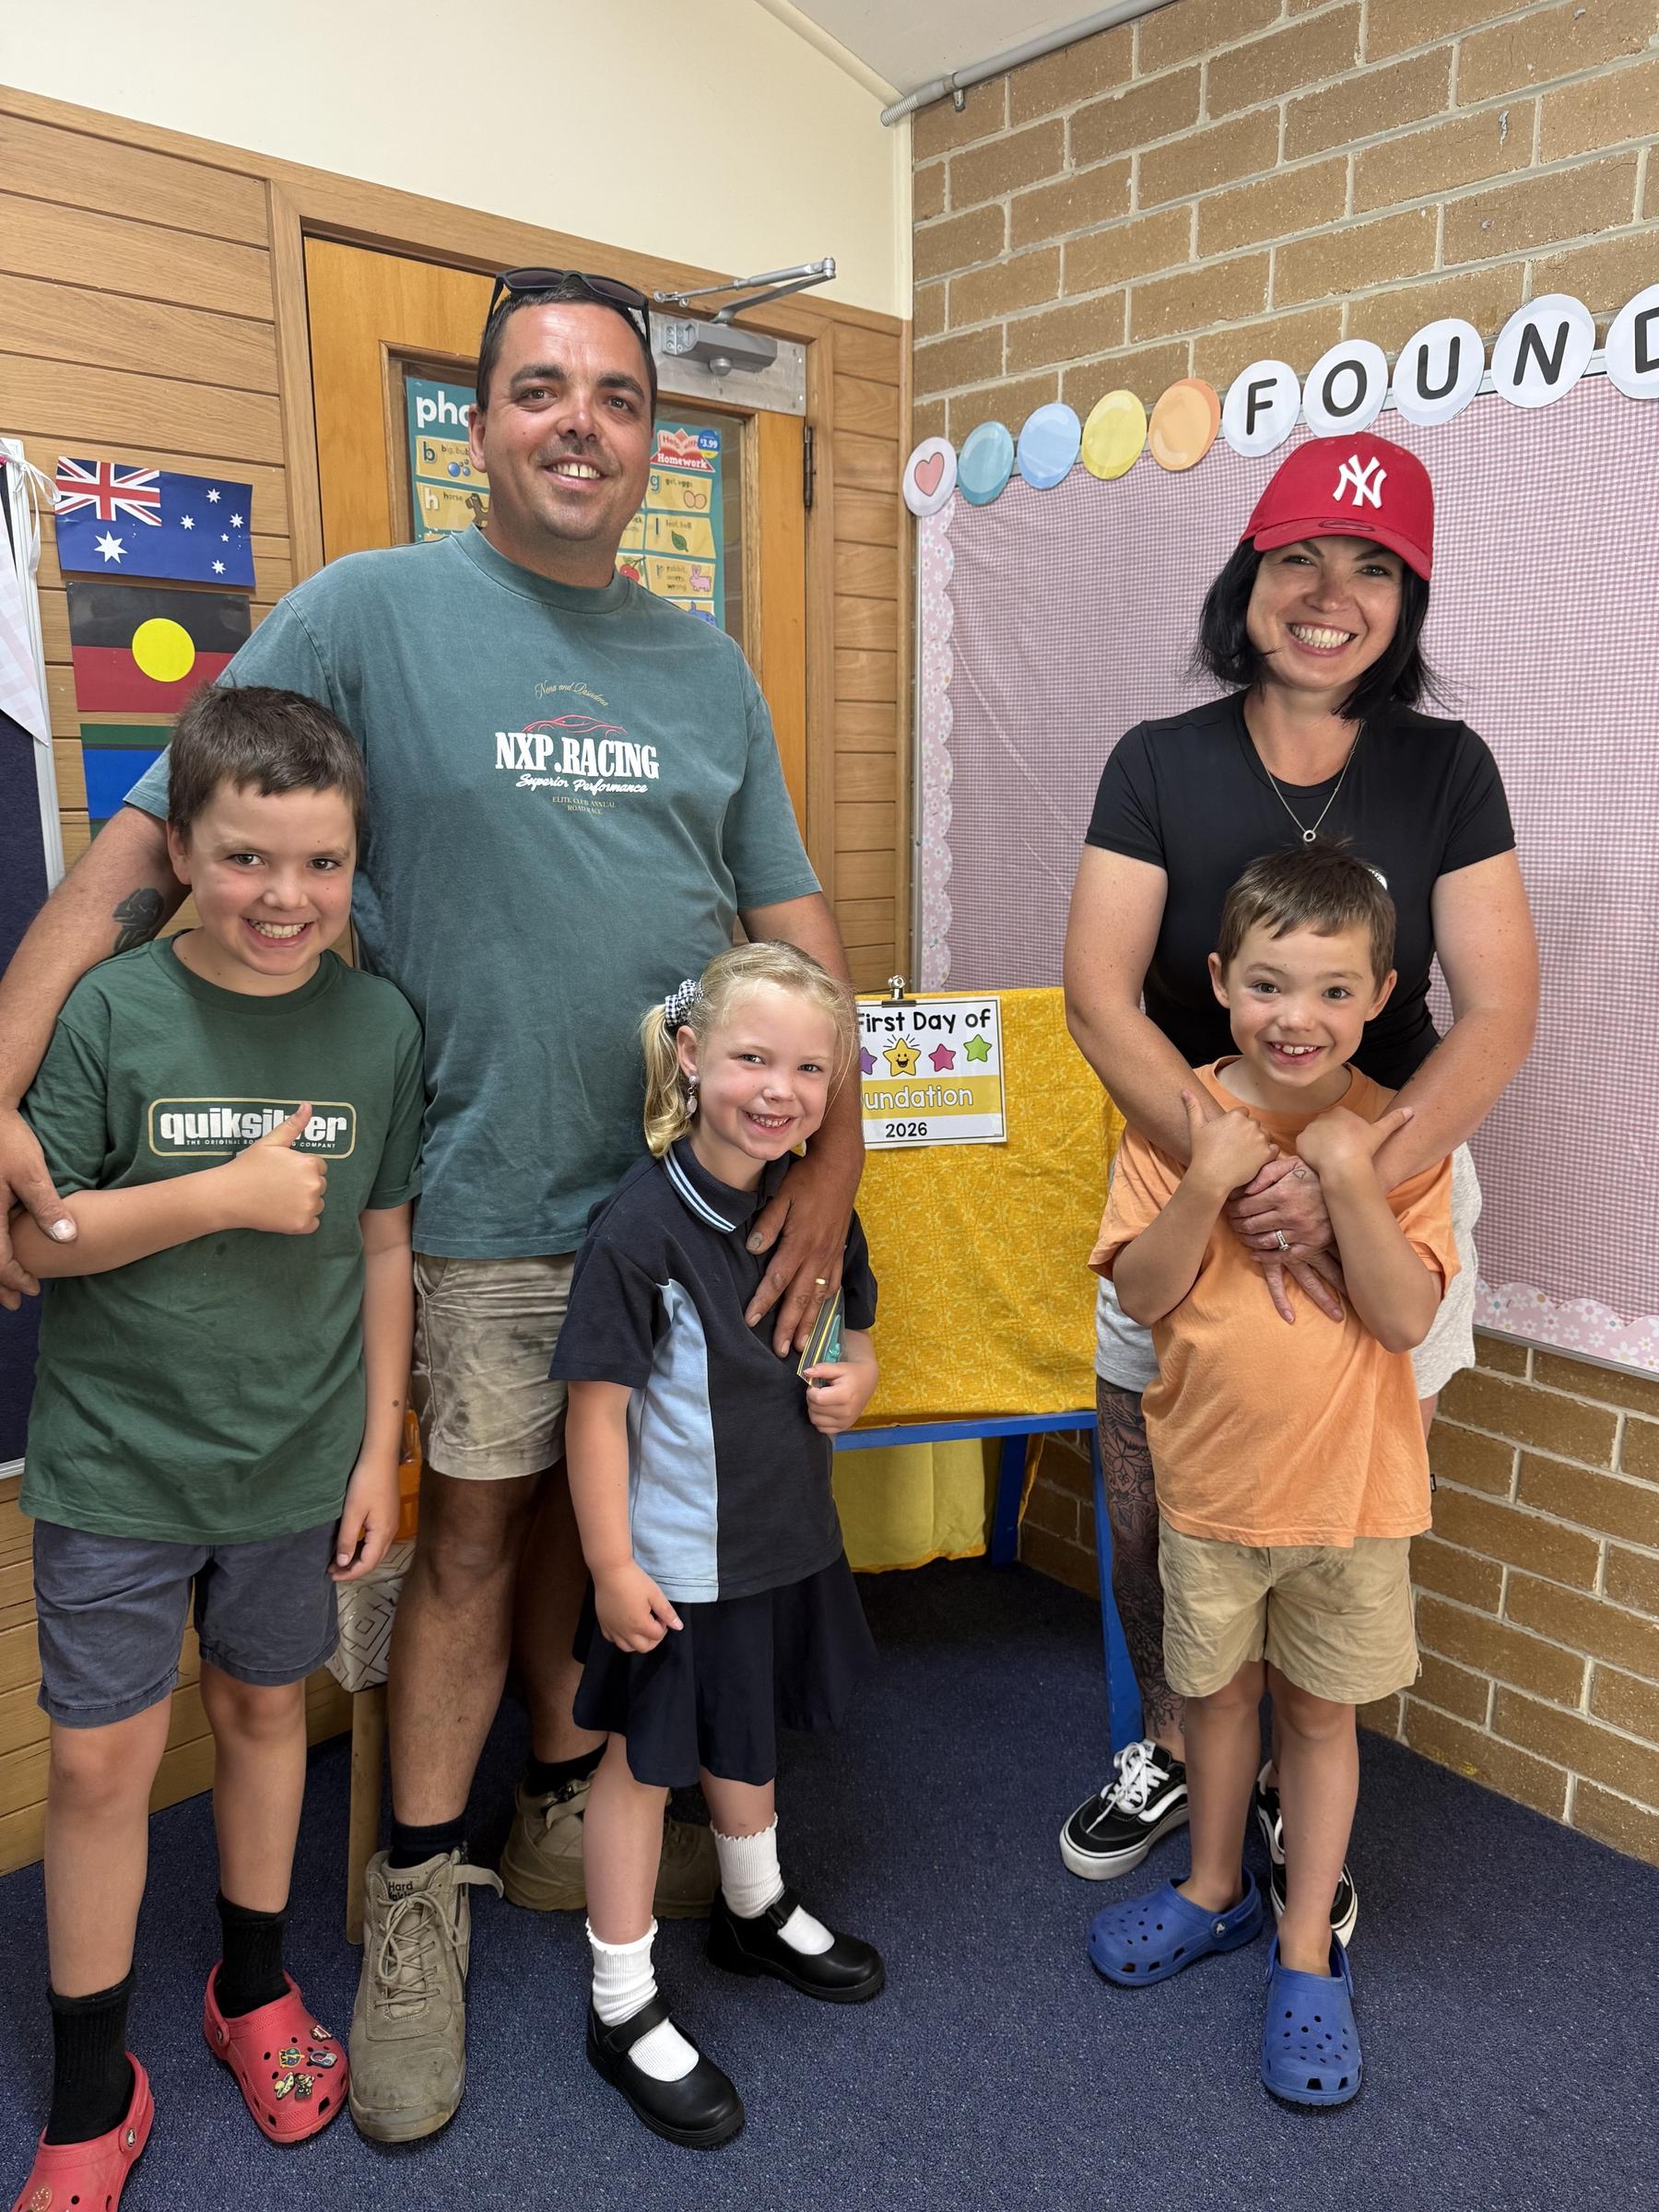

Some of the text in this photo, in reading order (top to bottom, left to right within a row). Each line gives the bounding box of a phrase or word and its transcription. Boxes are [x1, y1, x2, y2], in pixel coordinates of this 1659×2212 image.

[422, 441, 436, 462] b
[700, 438, 719, 449] $3.99
[657, 453, 708, 469] Homework
[1332, 454, 1387, 509] NY
[425, 487, 440, 511] h
[443, 491, 464, 501] horse
[559, 682, 574, 691] and
[495, 732, 660, 780] NXP.RACING
[516, 773, 649, 796] Superior Performance
[590, 800, 616, 808] ANNUAL
[913, 1011, 957, 1034] Day
[965, 1008, 992, 1029] of
[862, 1084, 974, 1111] undation
[160, 1108, 347, 1146] quiksiler
[886, 1122, 927, 1138] 2026
[388, 1881, 413, 1890] Hard
